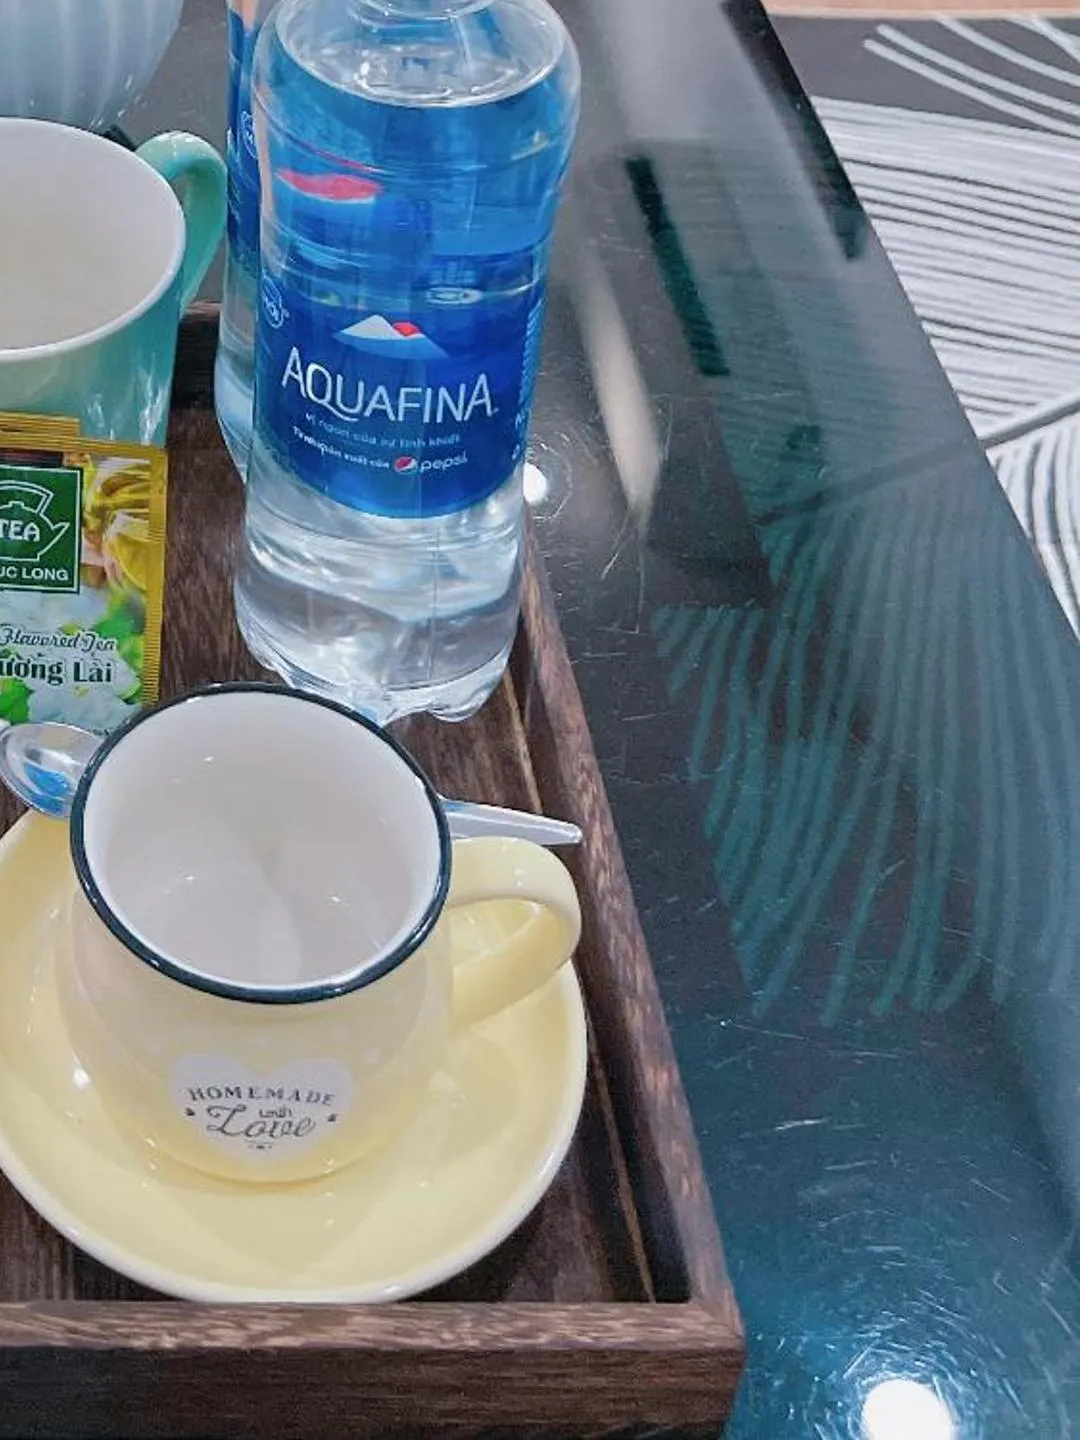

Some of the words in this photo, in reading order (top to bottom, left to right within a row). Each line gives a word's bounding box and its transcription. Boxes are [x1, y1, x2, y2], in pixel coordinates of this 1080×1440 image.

[281, 347, 495, 423] AQUAFINA
[420, 451, 468, 473] pepsi
[21, 567, 69, 581] LONG
[81, 632, 116, 653] Tea
[73, 656, 112, 683] Lài
[186, 1086, 336, 1106] HOMEMADE
[206, 1104, 317, 1138] Love
